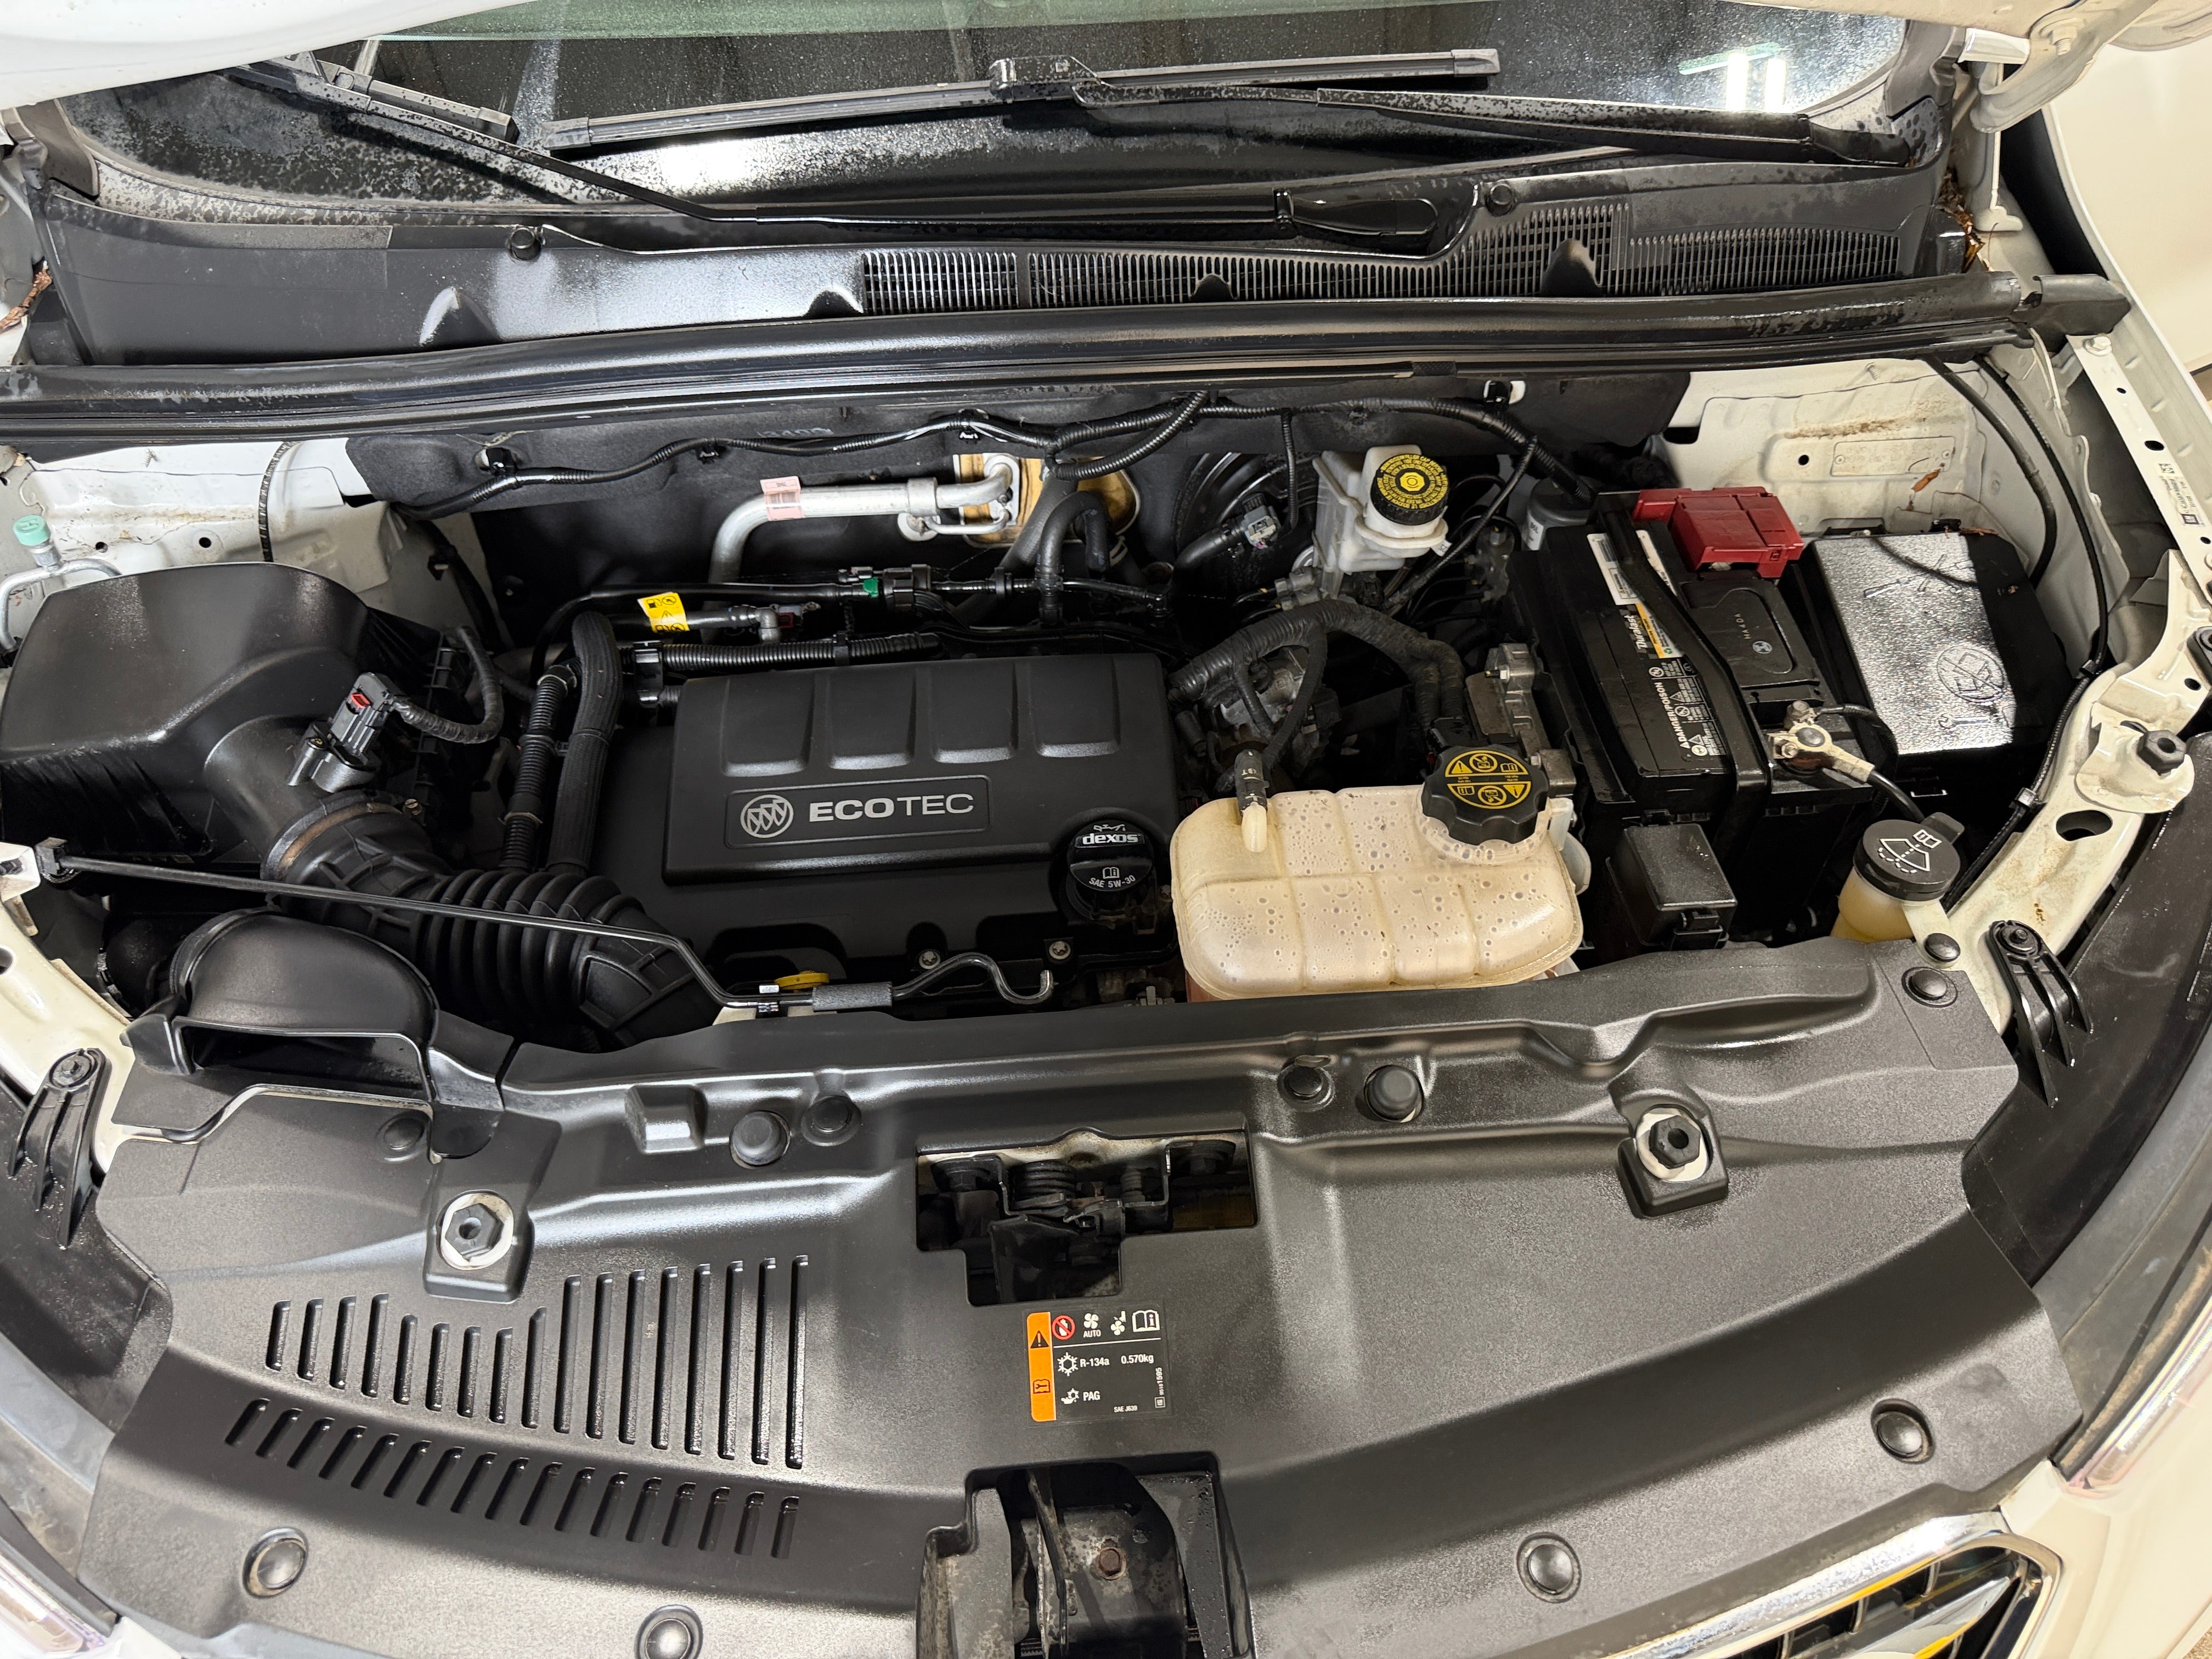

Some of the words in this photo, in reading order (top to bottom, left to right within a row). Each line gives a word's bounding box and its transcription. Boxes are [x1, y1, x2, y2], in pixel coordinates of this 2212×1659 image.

[1624, 614, 1648, 650] Duralast
[1654, 682, 1688, 742] DANGER/POISON
[809, 793, 974, 822] ECOTEC
[1082, 833, 1138, 845] dexos
[1089, 878, 1105, 888] SAE
[1108, 874, 1136, 888] 5W-30
[1083, 1329, 1101, 1338] AUTO
[1080, 1357, 1110, 1367] R-134a
[1121, 1355, 1154, 1364] 0.570kg
[1083, 1391, 1101, 1401] PAG
